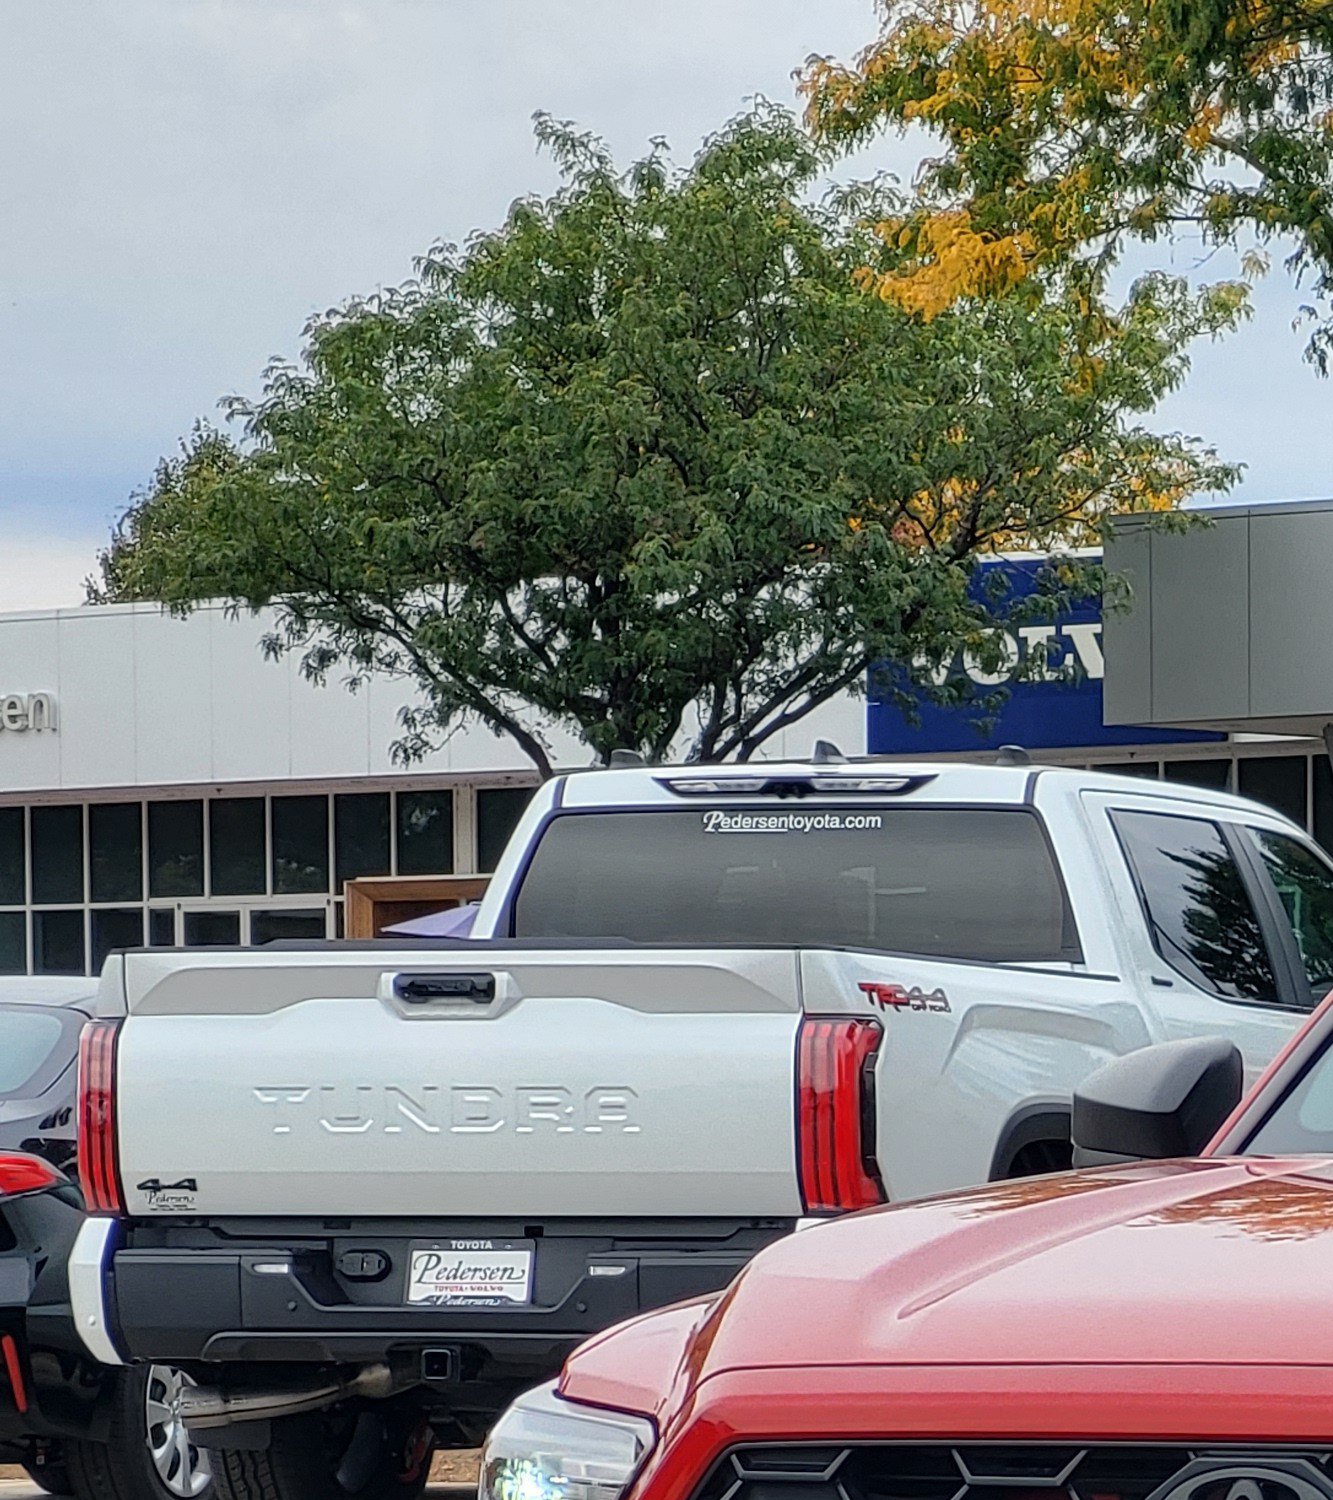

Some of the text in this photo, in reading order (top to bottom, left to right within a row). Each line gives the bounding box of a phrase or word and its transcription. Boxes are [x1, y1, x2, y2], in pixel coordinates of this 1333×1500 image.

[0, 693, 57, 732] en
[703, 811, 882, 832] Pedersentoyota.com
[253, 1086, 641, 1133] TUNDRA
[450, 1240, 493, 1250] TOYOTA
[413, 1253, 526, 1284] Pedersen
